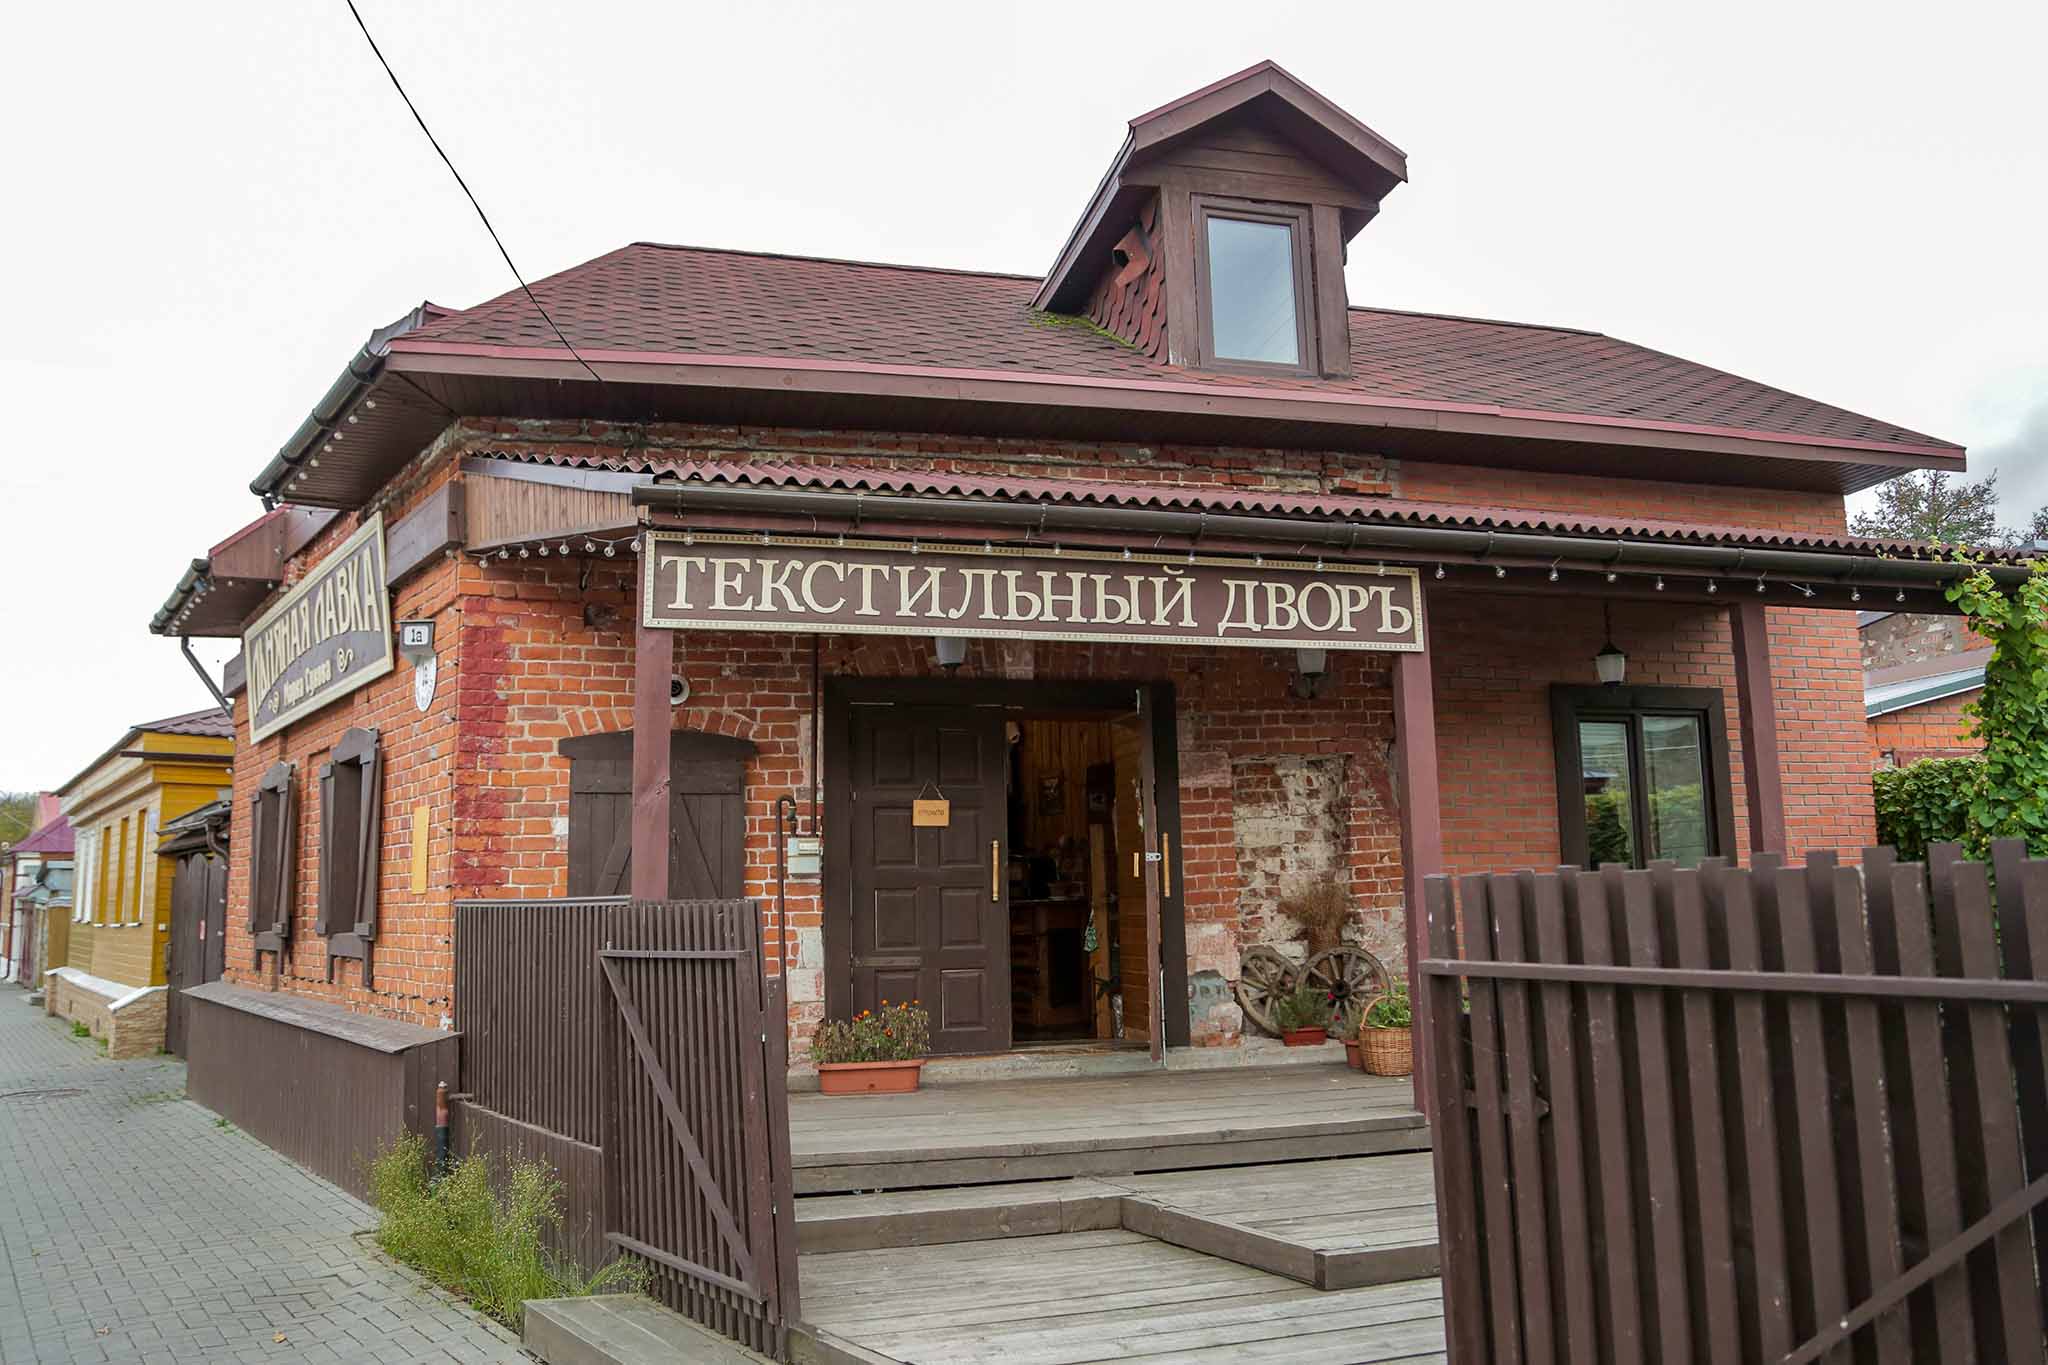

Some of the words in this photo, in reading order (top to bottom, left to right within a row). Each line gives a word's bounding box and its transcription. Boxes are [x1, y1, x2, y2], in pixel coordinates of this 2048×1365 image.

[314, 545, 382, 645] ЛАВКА
[659, 555, 1199, 628] ТЕКСТИЛЬНЫЙ
[1216, 578, 1414, 637] ДВОРЪ
